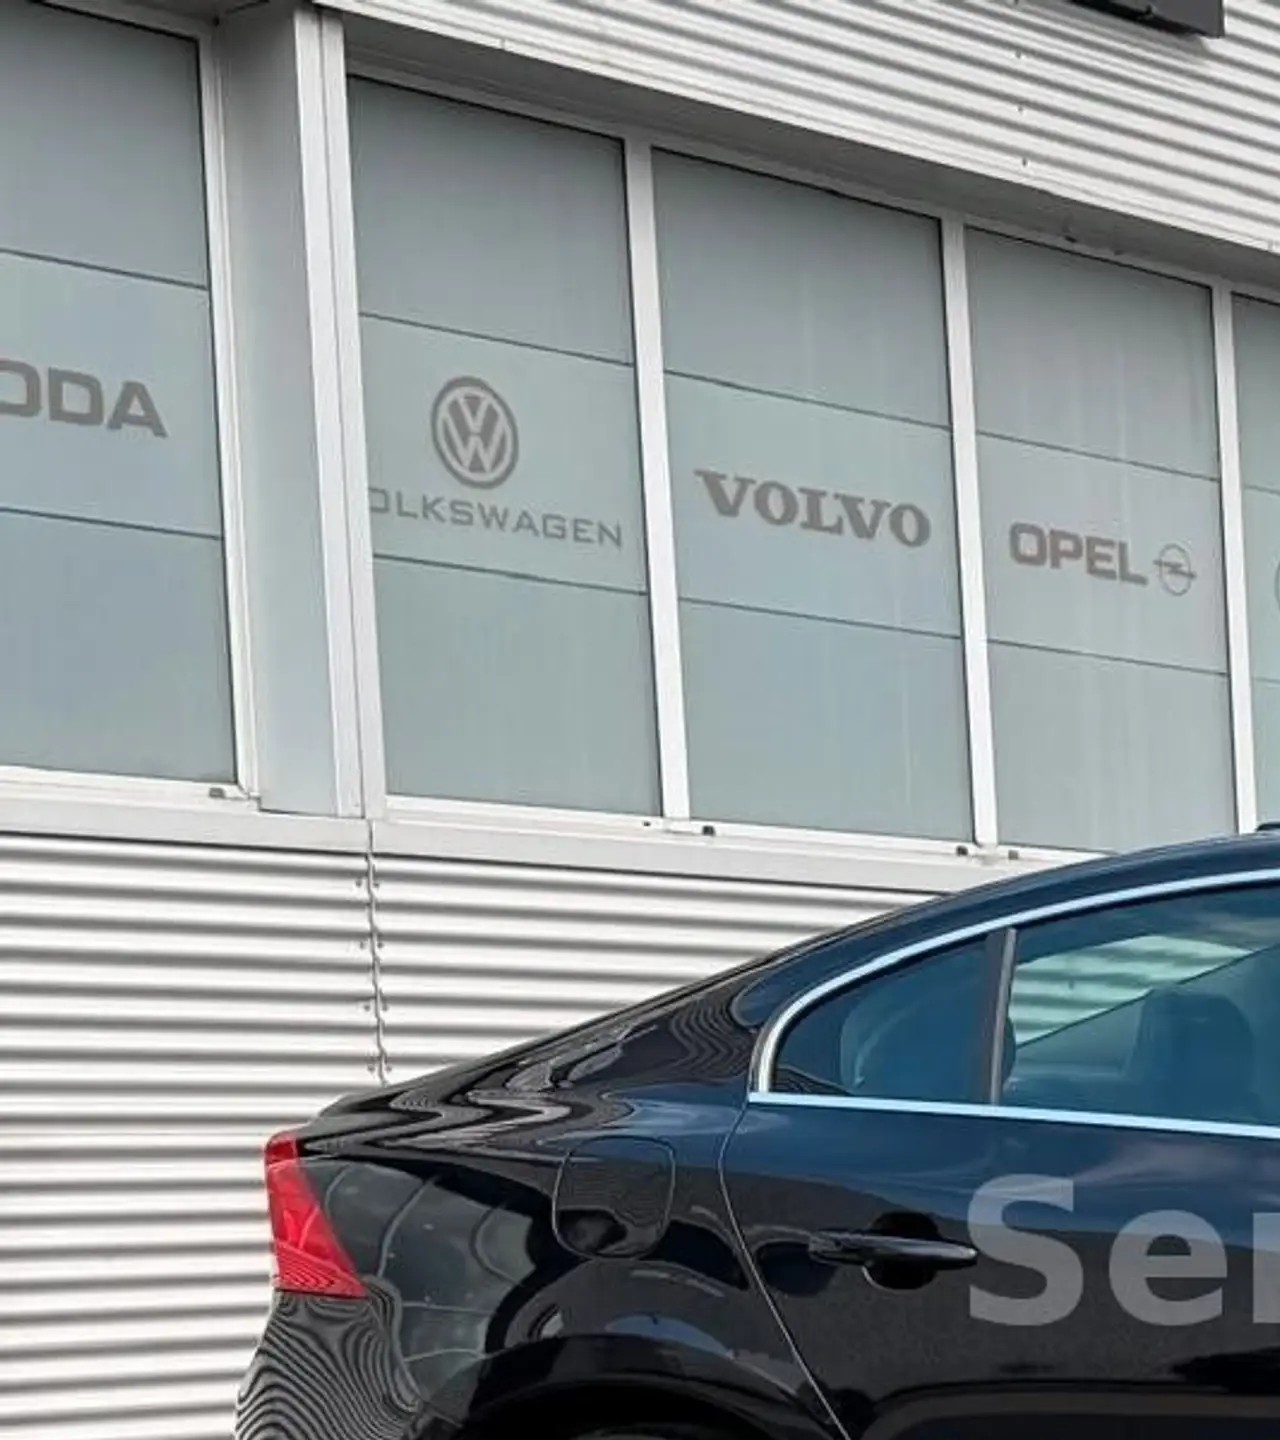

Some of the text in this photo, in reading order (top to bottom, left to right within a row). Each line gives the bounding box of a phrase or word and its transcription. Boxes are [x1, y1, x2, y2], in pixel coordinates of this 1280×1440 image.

[0, 359, 169, 439] ODA
[367, 486, 623, 548] OLKSWAGEN
[694, 468, 932, 549] VOLVO
[1008, 522, 1148, 587] OPEL
